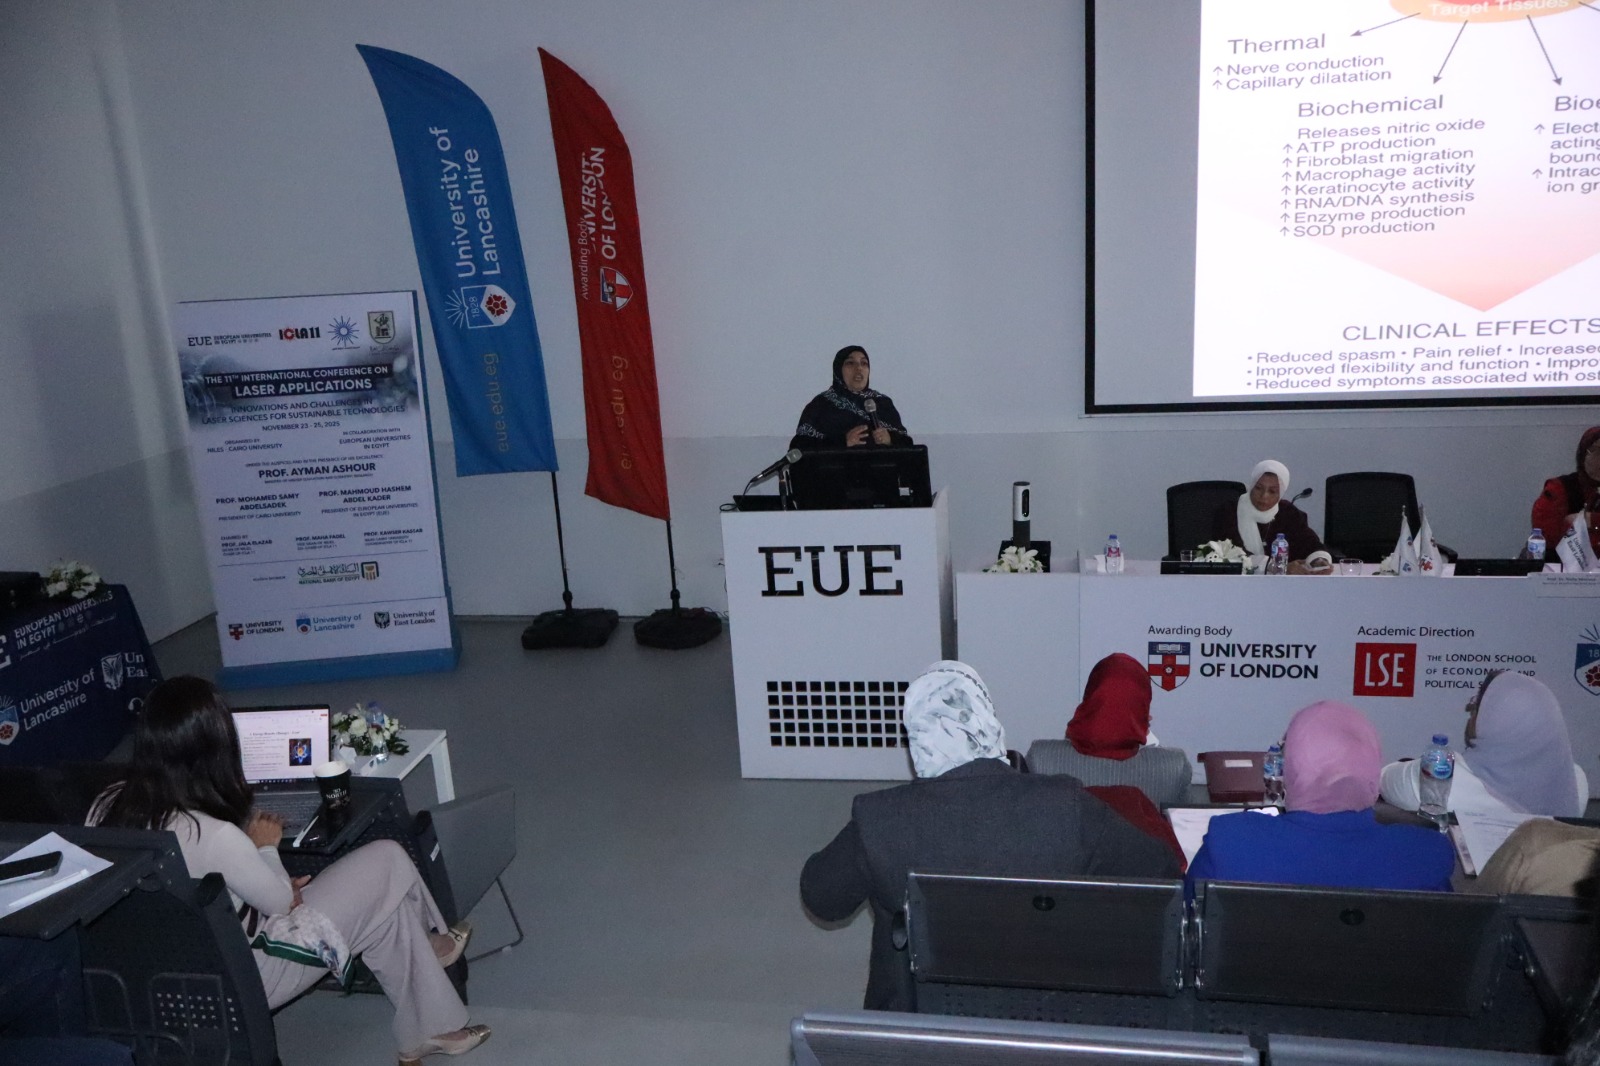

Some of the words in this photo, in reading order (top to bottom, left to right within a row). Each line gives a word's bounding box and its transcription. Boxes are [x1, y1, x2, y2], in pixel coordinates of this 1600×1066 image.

[1429, 2, 1489, 17] Target
[1498, 0, 1569, 12] Tissues
[1228, 33, 1327, 55] Thermal
[1227, 62, 1280, 76] Nerve
[1285, 55, 1385, 72] conduction
[1226, 76, 1305, 91] Capillary
[1310, 69, 1392, 85] dilatation
[1298, 95, 1444, 117] Biochemical
[1298, 126, 1381, 139] Releases
[1387, 122, 1431, 135] nitric
[1435, 118, 1486, 132] oxide
[429, 126, 451, 151] of
[1296, 141, 1335, 154] ATP
[1340, 136, 1436, 153] production
[1296, 152, 1385, 167] Fibroblast
[1390, 148, 1474, 163] migration
[1295, 166, 1407, 183] Macrophage
[1412, 162, 1476, 178] activity
[1295, 180, 1408, 197] Keratinocyte
[1412, 177, 1475, 193] activity
[1547, 181, 1575, 193] ion
[1295, 194, 1384, 210] RNA/DNA
[1389, 191, 1475, 208] synthesis
[440, 159, 476, 278] University
[464, 149, 501, 275] Lancashire
[1295, 209, 1366, 225] Enzyme
[1371, 206, 1466, 222] production
[578, 218, 589, 245] Body
[1293, 224, 1335, 237] SOD
[1341, 220, 1435, 236] production
[602, 235, 616, 260] OF
[578, 248, 591, 300] Awarding
[468, 296, 479, 318] 1828
[1342, 323, 1467, 341] CLINICAL
[1476, 318, 1600, 337] EFFECTS
[188, 336, 212, 347] EUE
[1257, 351, 1333, 363] Reduced
[1338, 350, 1396, 362] spasm
[1413, 347, 1452, 359] Pain
[1458, 345, 1502, 357] relief
[205, 376, 223, 384] THE
[241, 370, 312, 382] INTERNATIONAL
[313, 367, 373, 379] CONFERENCE
[374, 365, 388, 374] ON
[1256, 363, 1335, 378] Improved
[1341, 360, 1415, 375] flexibility
[1424, 359, 1453, 371] and
[1459, 358, 1529, 370] function
[235, 385, 275, 397] LASER
[279, 378, 372, 394] APPLICATIONS
[1255, 377, 1332, 390] Reduced
[1337, 374, 1426, 389] symptoms
[1432, 372, 1527, 385] associated
[1533, 370, 1569, 383] with
[231, 403, 288, 413] INNOVATIONS
[291, 402, 308, 410] AND
[484, 353, 509, 452] eue.edu.eg
[202, 414, 228, 424] LASER
[229, 413, 268, 423] SCIENCES
[270, 411, 288, 420] FOR
[289, 408, 342, 419] SUSTAINABLE
[343, 405, 405, 416] TECHNOLOGIES
[262, 423, 299, 432] NOVEMBER
[373, 435, 411, 443] UNIVERSITIES
[258, 469, 289, 479] PROF.
[291, 466, 330, 477] AYMAN
[332, 463, 376, 473] ASHOUR
[238, 495, 278, 503] MOHAMED
[341, 487, 380, 496] MAHMOUD
[381, 485, 412, 493] HASHEM
[343, 496, 365, 504] ABDEL
[367, 494, 391, 502] KADER
[240, 502, 287, 512] ABDELSADEK
[758, 544, 903, 597] EUE
[245, 620, 282, 628] UNIVERSITY
[313, 616, 352, 624] University
[354, 613, 362, 621] of
[393, 611, 427, 620] University
[394, 618, 408, 626] East
[409, 617, 436, 625] London
[14, 612, 61, 639] EUROPEAN
[256, 626, 284, 634] LONDON
[314, 622, 355, 631] Lancashire
[1148, 625, 1201, 637] Awarding
[1204, 626, 1233, 638] Body
[1358, 626, 1416, 637] Academic
[1419, 627, 1475, 638] Direction
[16, 637, 27, 650] IN
[29, 625, 56, 645] EGYPT
[1201, 643, 1317, 659] UNIVERSITY
[1446, 654, 1491, 663] LONDON
[1495, 655, 1537, 663] SCHOOL
[1200, 663, 1226, 677] OF
[1231, 664, 1319, 679] LONDON
[1364, 652, 1405, 688] LSE
[21, 676, 79, 714] University
[82, 668, 95, 685] of
[1425, 680, 1475, 689] POLITICAL
[23, 693, 87, 731] Lancashire
